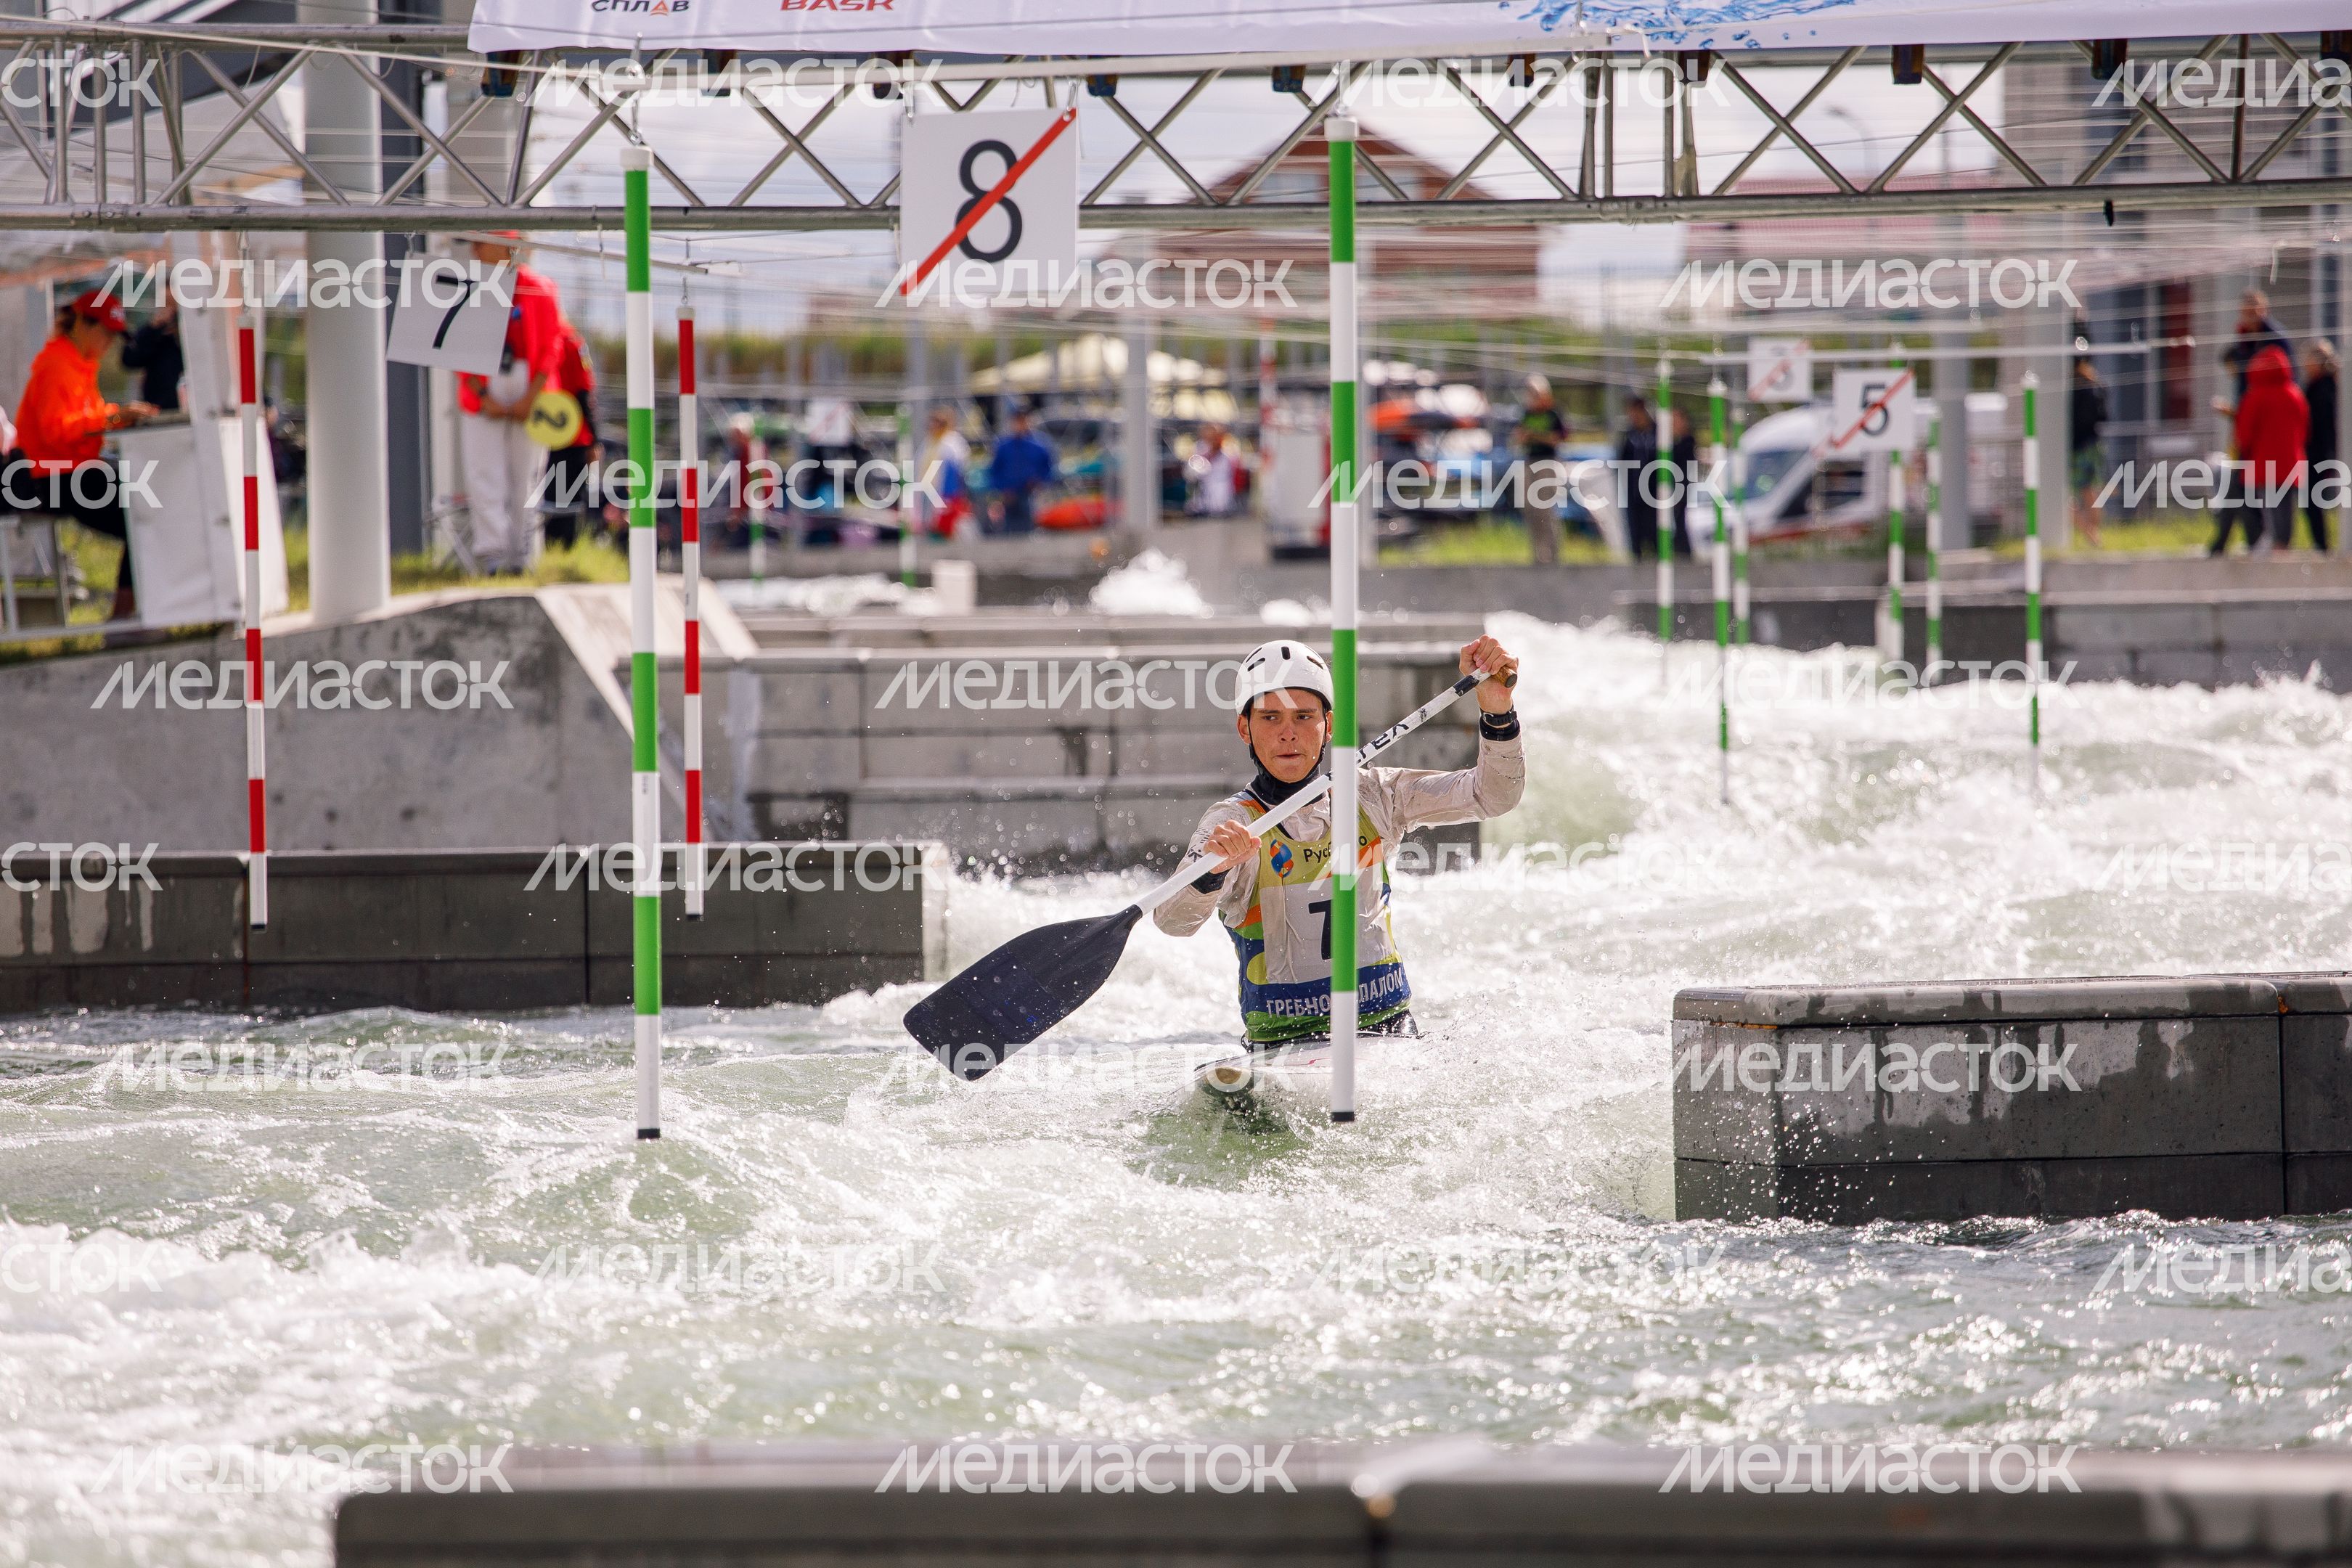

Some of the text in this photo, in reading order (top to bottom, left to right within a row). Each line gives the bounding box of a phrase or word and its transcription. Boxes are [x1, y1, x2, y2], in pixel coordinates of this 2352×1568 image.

[955, 139, 1023, 263] 8
[432, 274, 481, 350] 7
[1861, 383, 1888, 436] 5
